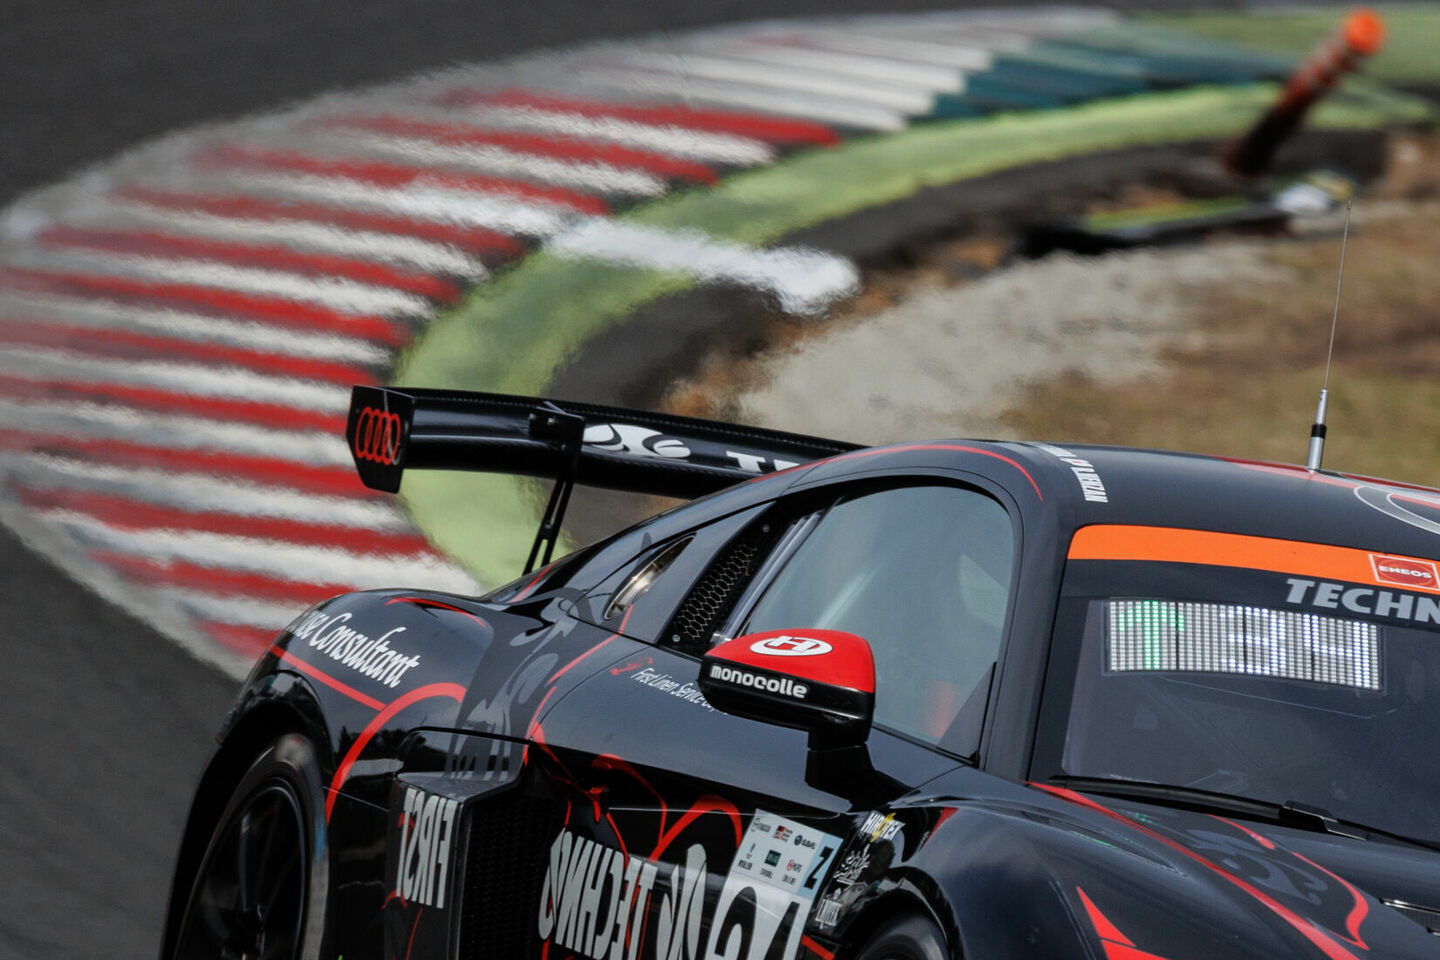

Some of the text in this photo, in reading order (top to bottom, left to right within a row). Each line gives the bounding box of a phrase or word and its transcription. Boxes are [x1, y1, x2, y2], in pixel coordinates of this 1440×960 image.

[1378, 565, 1433, 579] ENEOS
[309, 612, 421, 688] Consultant
[709, 663, 808, 699] monocolle
